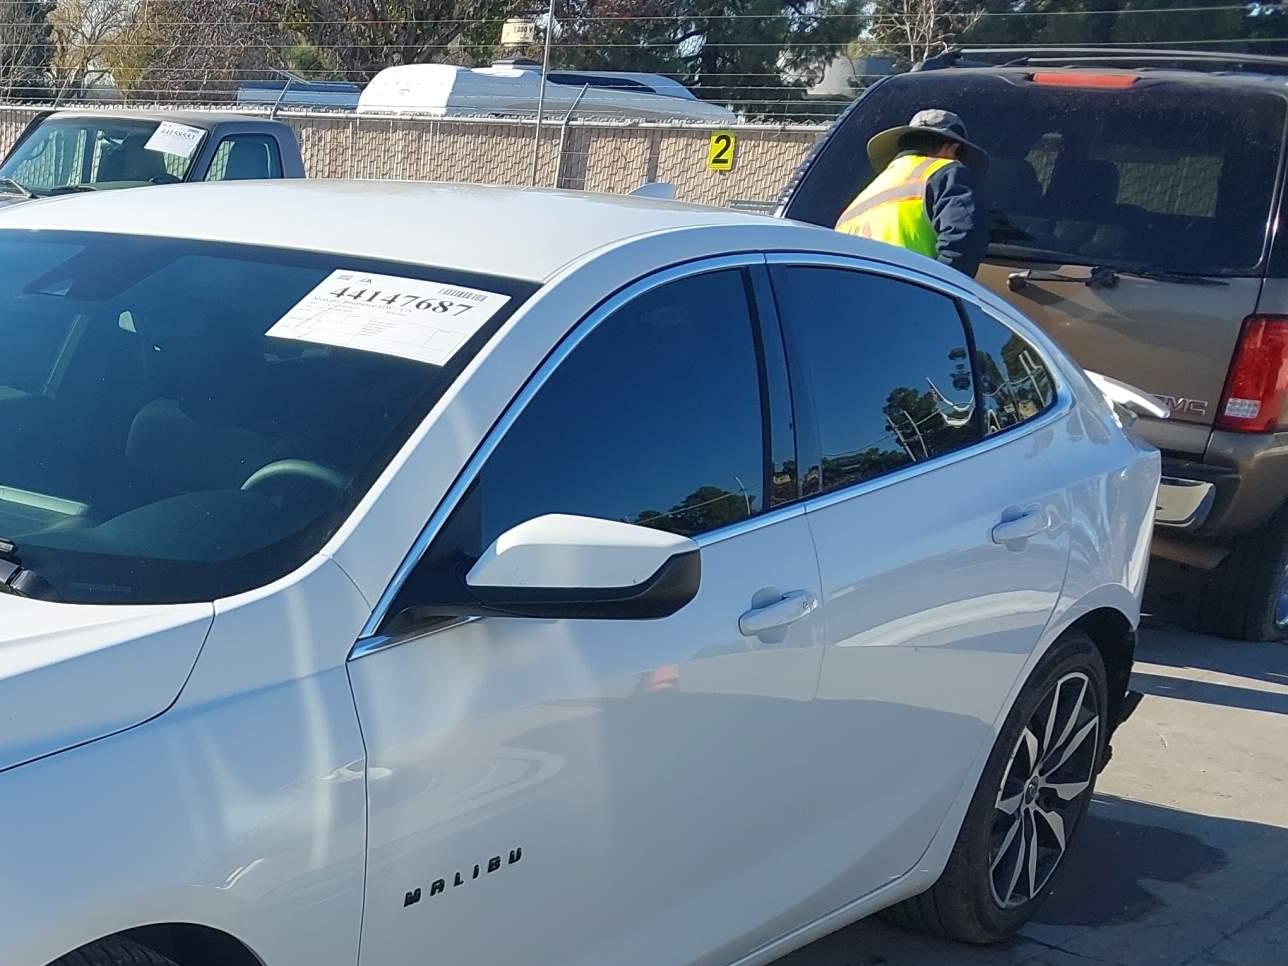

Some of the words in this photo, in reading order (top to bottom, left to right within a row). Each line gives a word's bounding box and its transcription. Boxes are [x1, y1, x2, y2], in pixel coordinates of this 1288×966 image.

[711, 134, 732, 164] 2
[329, 286, 473, 317] 44147687
[1152, 394, 1209, 416] MC
[403, 847, 523, 908] MALIBU
